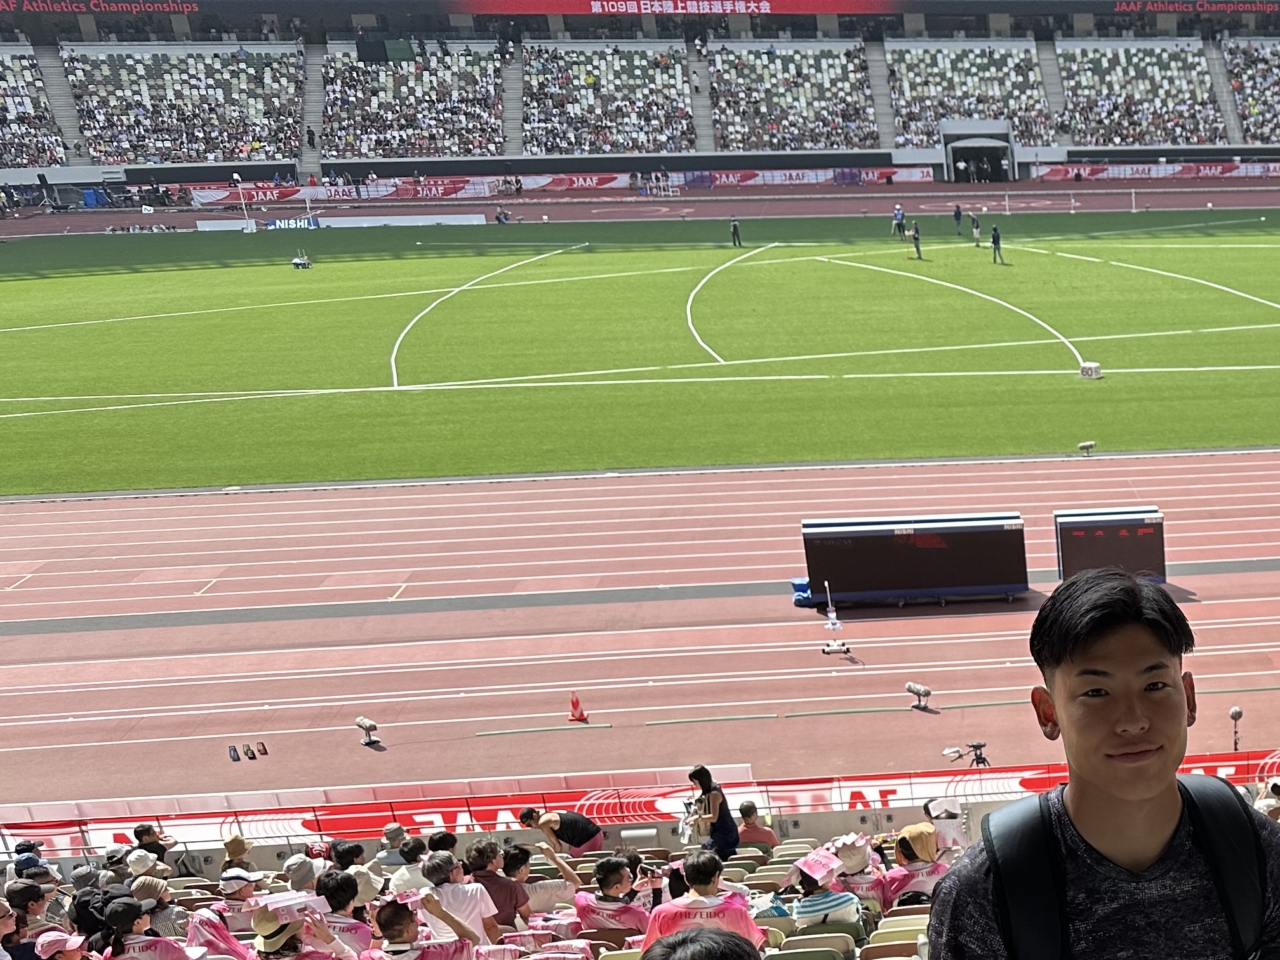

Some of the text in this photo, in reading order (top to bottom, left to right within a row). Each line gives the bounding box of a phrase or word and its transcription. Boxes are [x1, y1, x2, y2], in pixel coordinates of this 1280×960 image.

[0, 1, 199, 15] AF Athletics Championships
[640, 1, 772, 14] 日本陸上競技選手権大会
[1114, 1, 1279, 14] JAAF Athletics Championships
[1199, 166, 1223, 175] JAAF
[572, 177, 599, 188] JAAF
[782, 172, 807, 182] JAAF
[251, 189, 279, 201] JAAF
[417, 187, 445, 197] JAAF
[275, 219, 309, 229] NISHI
[669, 910, 726, 920] SHISEIDO
[124, 944, 158, 955] SEIDO
